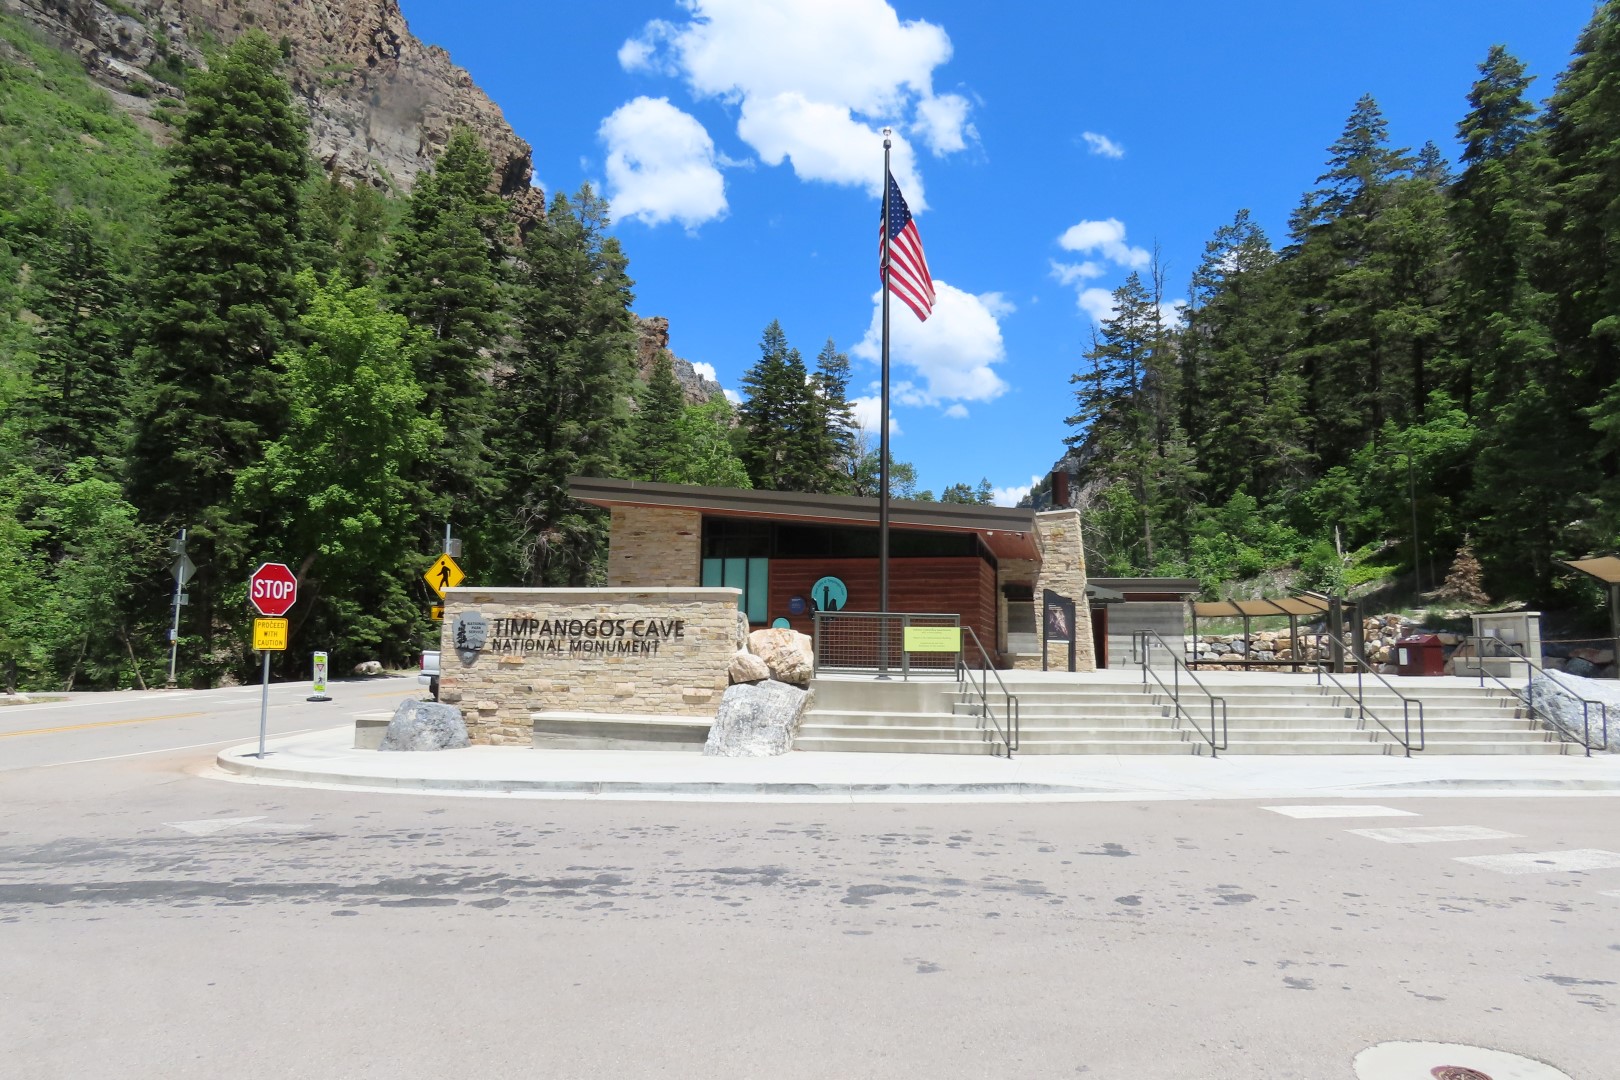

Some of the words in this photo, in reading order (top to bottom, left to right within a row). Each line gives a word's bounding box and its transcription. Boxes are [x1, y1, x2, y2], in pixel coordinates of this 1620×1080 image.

[254, 579, 293, 599] STOP
[493, 618, 625, 637] TIMPANOGOS
[632, 619, 685, 637] CAVE
[492, 638, 565, 652] NATIONAL
[569, 640, 661, 653] MONUMENT
